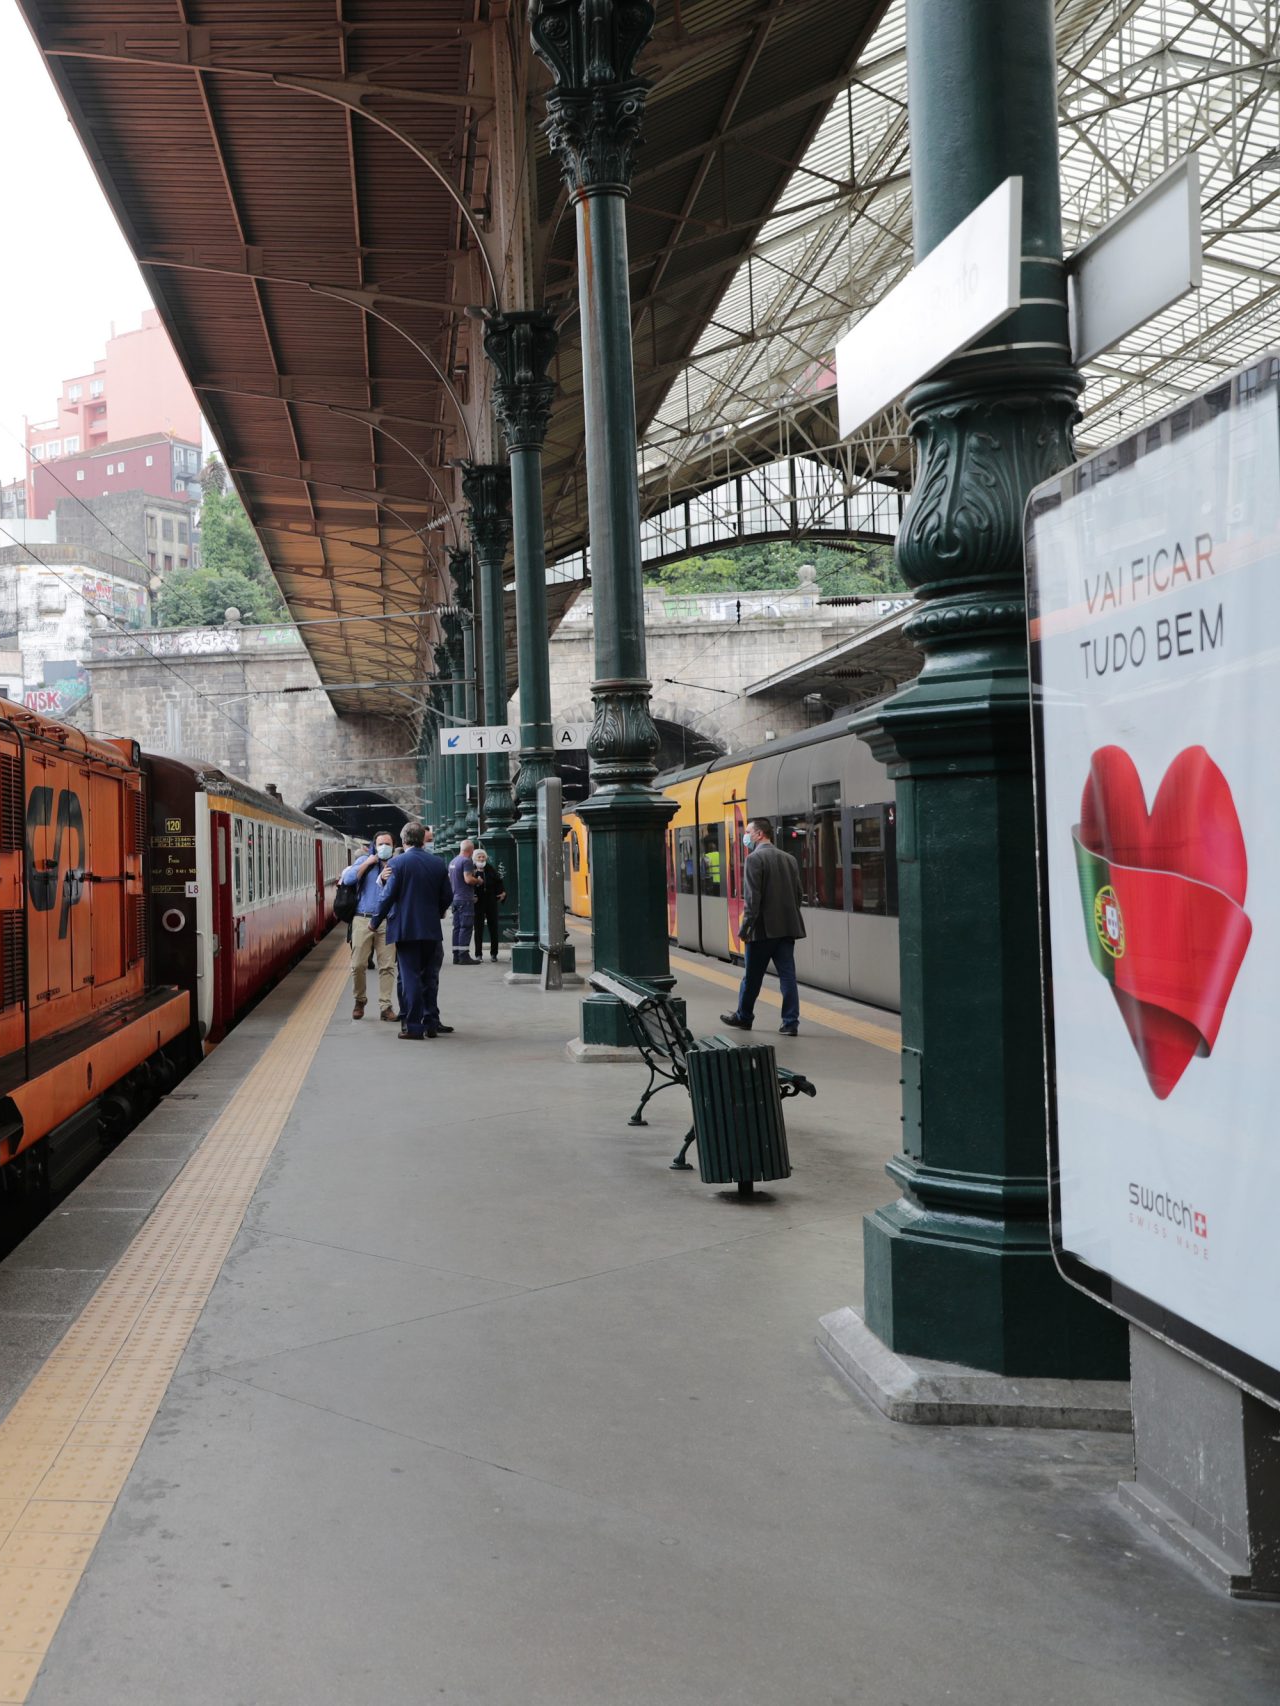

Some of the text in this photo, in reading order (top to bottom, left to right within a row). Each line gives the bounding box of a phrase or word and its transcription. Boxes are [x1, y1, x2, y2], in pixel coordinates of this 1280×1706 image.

[1084, 532, 1215, 615] VAI FICAR
[1080, 602, 1224, 680] TUDO BEM
[477, 733, 512, 748] 1 A
[561, 731, 572, 742] A
[166, 820, 180, 831] 120
[187, 884, 199, 894] L8
[1128, 1182, 1193, 1233] swatch
